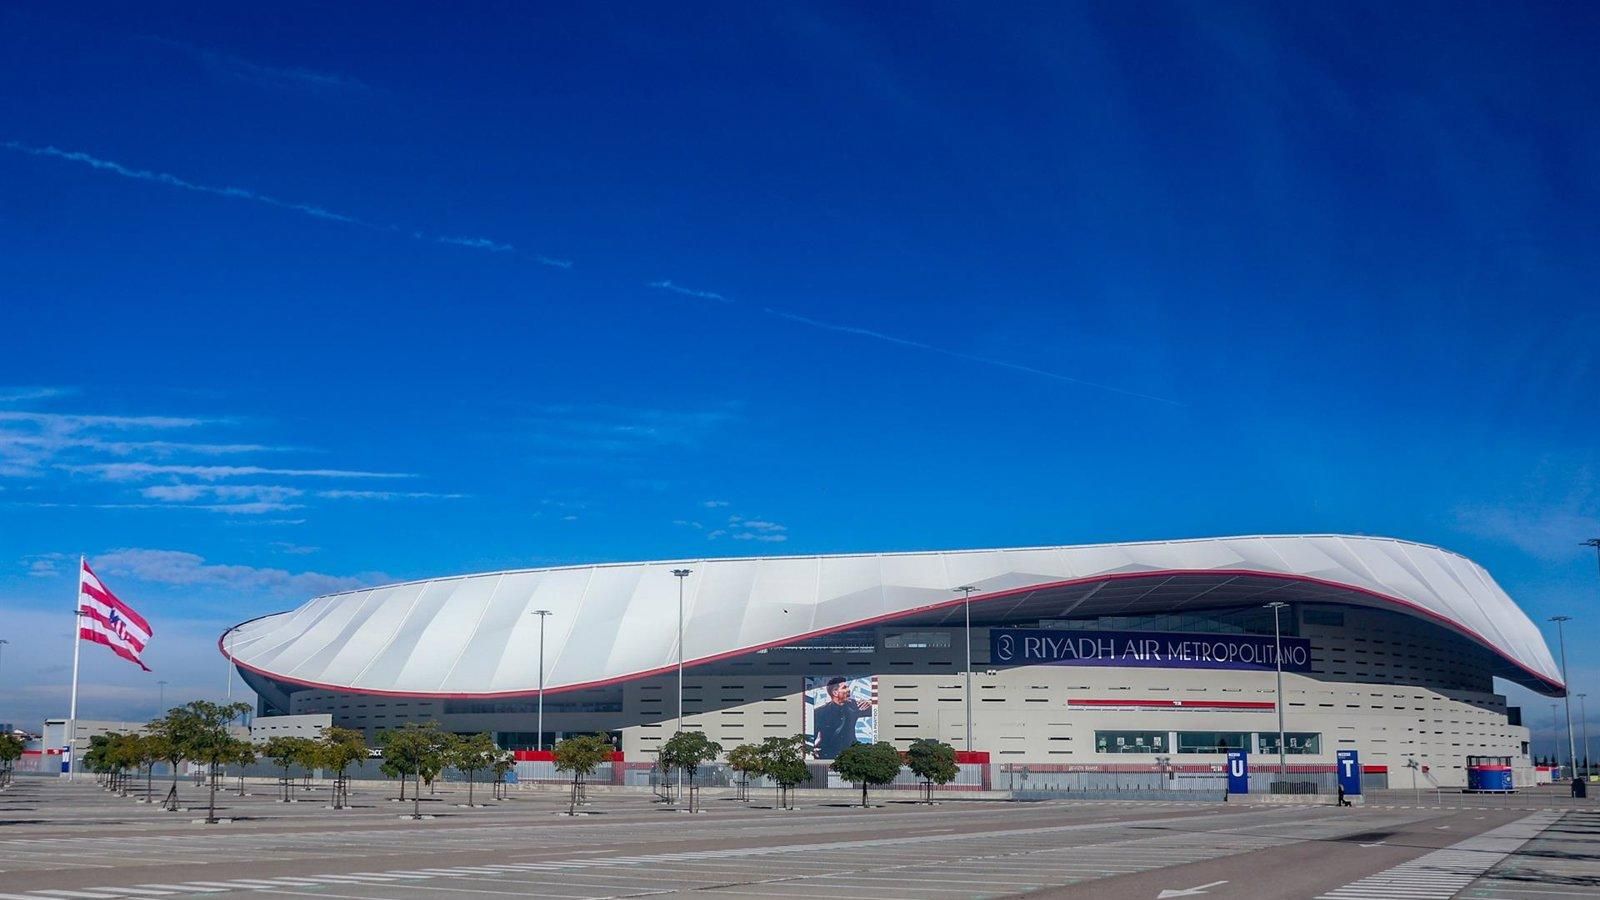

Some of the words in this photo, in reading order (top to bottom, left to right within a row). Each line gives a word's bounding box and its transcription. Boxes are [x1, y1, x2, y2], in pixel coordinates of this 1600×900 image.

[1024, 637, 1115, 660] RIYADH
[1122, 639, 1161, 661] AIR
[1168, 641, 1306, 666] METROPOLITANO
[1231, 759, 1244, 778] U
[1342, 759, 1354, 777] T
